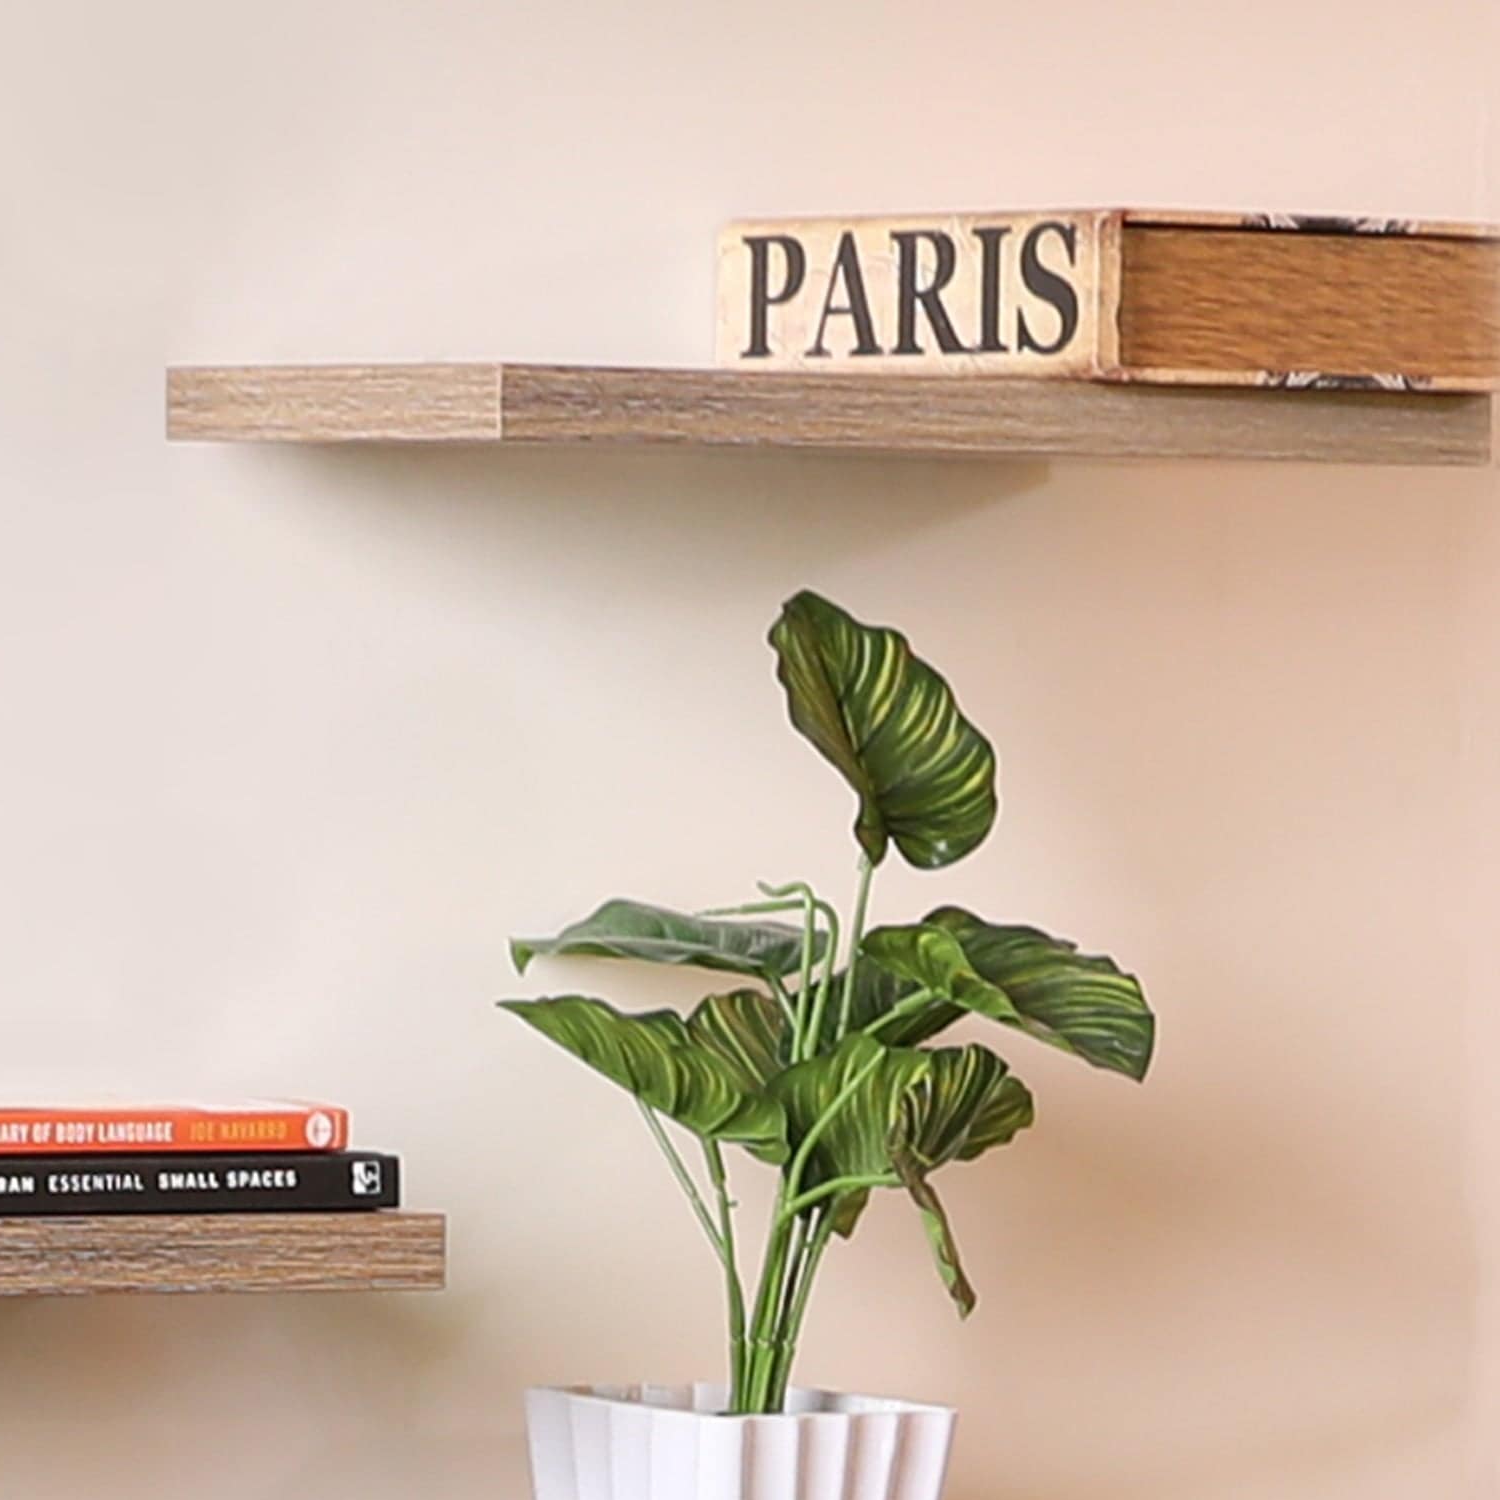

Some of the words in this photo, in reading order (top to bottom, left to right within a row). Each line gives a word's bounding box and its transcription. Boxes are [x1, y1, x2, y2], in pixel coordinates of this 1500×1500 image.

[740, 221, 1079, 358] PARIS
[32, 1123, 50, 1144] OF
[55, 1122, 94, 1144] BODY
[98, 1121, 173, 1143] LANGUAGE
[48, 1173, 145, 1193] ESSENTIAL
[158, 1172, 220, 1190] SMALL
[226, 1169, 297, 1188] SPACES
